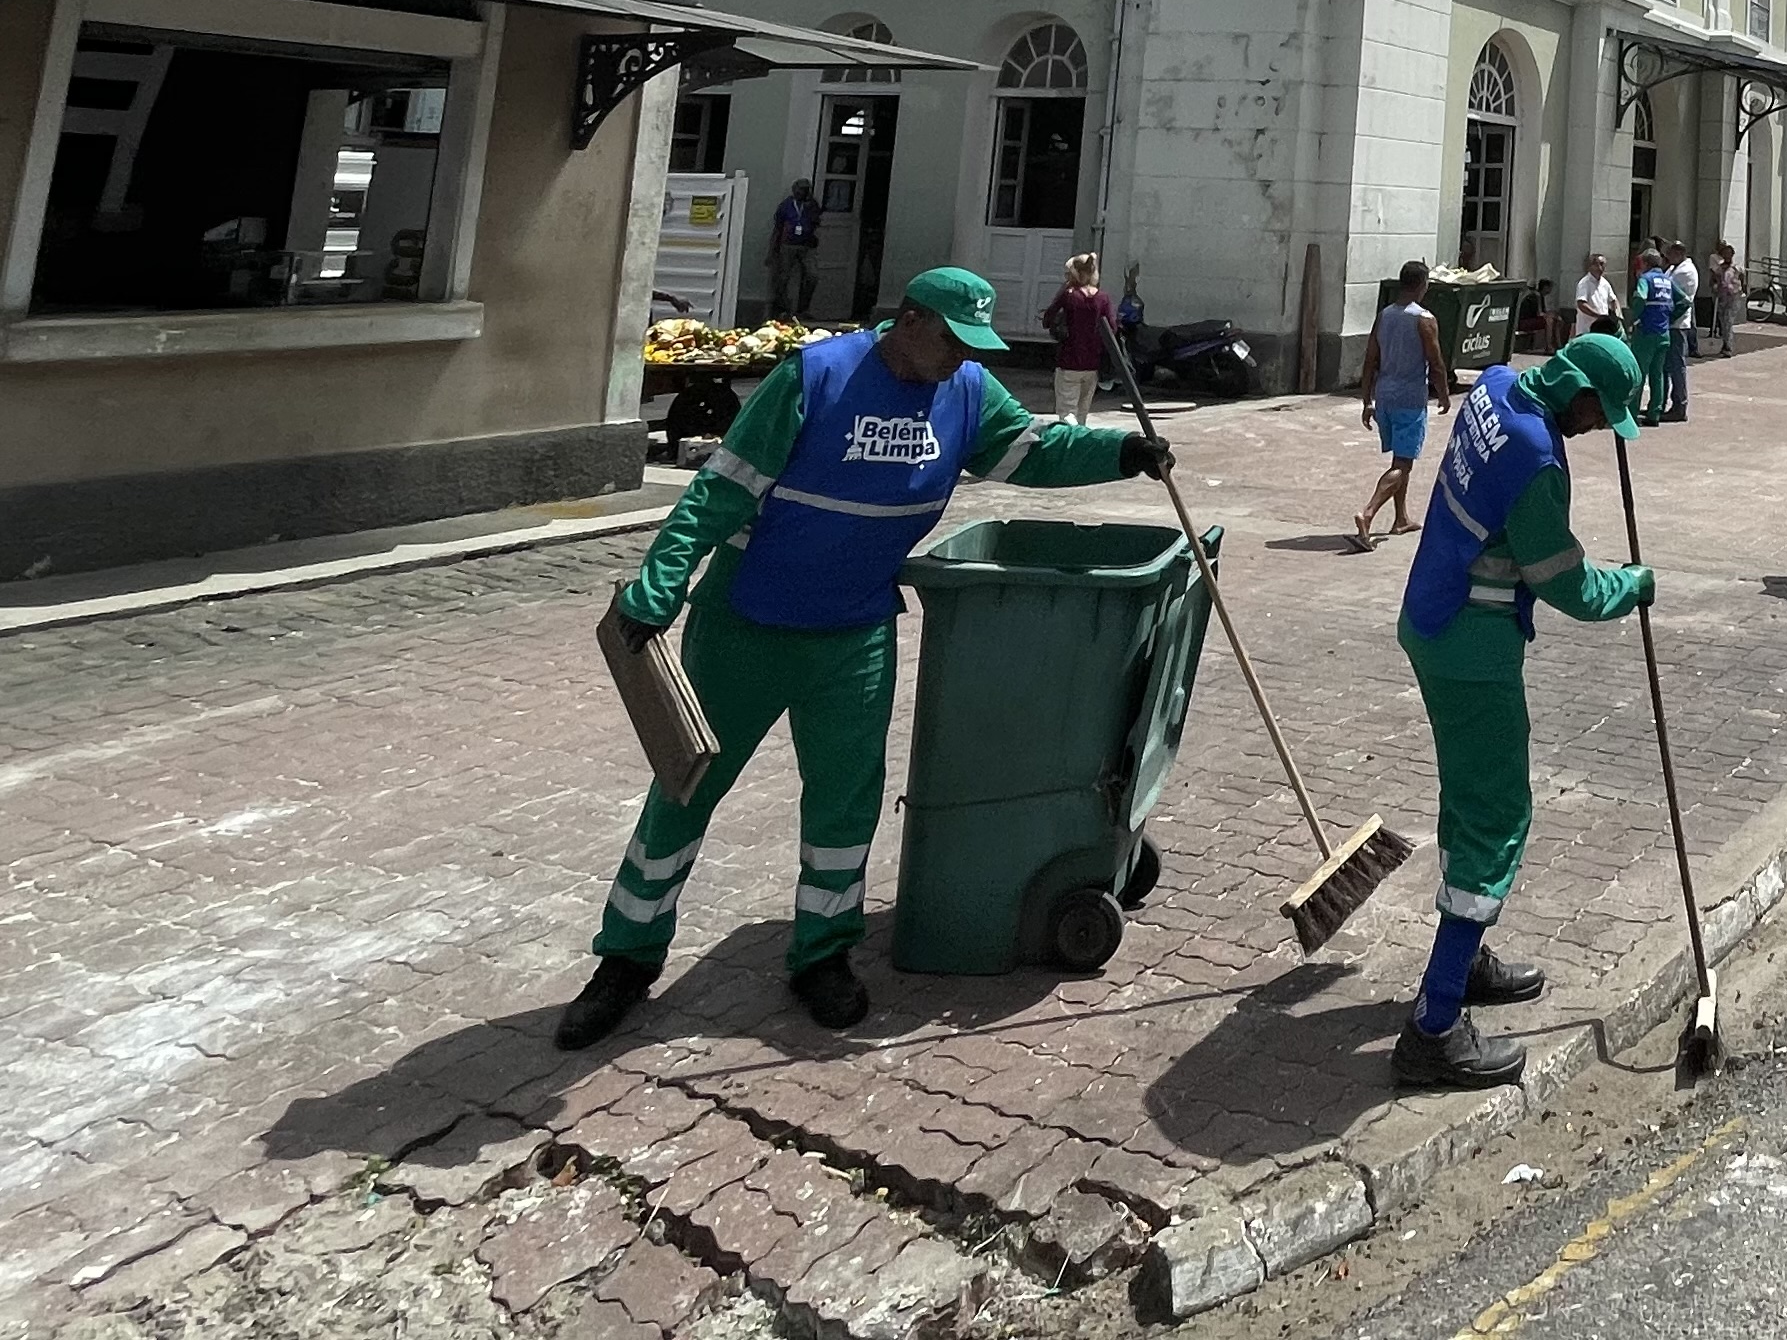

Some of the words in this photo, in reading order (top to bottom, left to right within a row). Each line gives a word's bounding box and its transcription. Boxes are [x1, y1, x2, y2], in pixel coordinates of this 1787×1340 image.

[1470, 383, 1509, 453] BELÉM
[861, 421, 929, 441] Belém
[868, 440, 936, 460] Limpa
